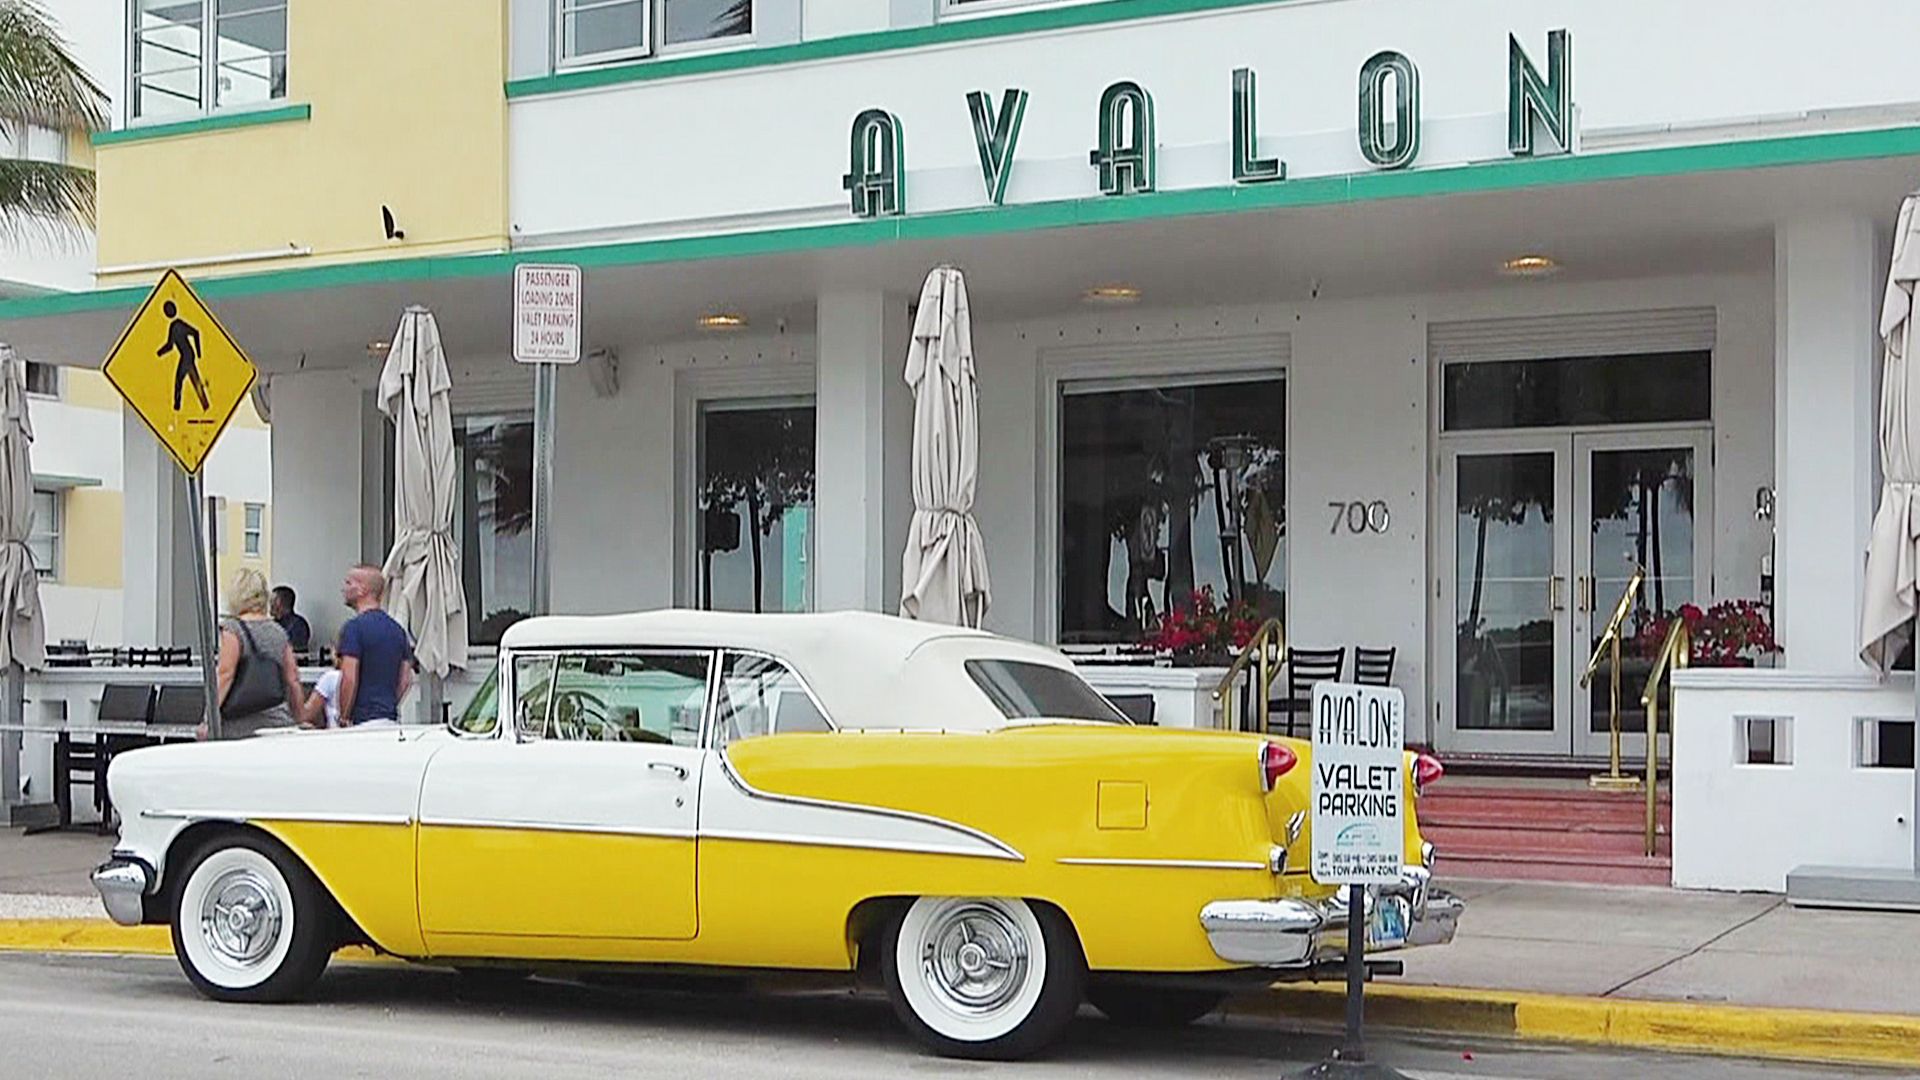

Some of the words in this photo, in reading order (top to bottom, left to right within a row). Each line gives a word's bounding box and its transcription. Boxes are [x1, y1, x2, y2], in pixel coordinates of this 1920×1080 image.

[842, 29, 1575, 218] AVALON
[525, 271, 570, 287] PASSENGER
[521, 290, 553, 306] LOADING
[555, 291, 574, 307] ZONE
[521, 311, 542, 327] VALET
[543, 312, 574, 329] PARKING
[540, 330, 565, 346] HOURS
[1328, 500, 1390, 534] 700
[1319, 693, 1391, 748] AVALON
[1318, 763, 1397, 791] VALET
[1319, 793, 1397, 817] PARKING
